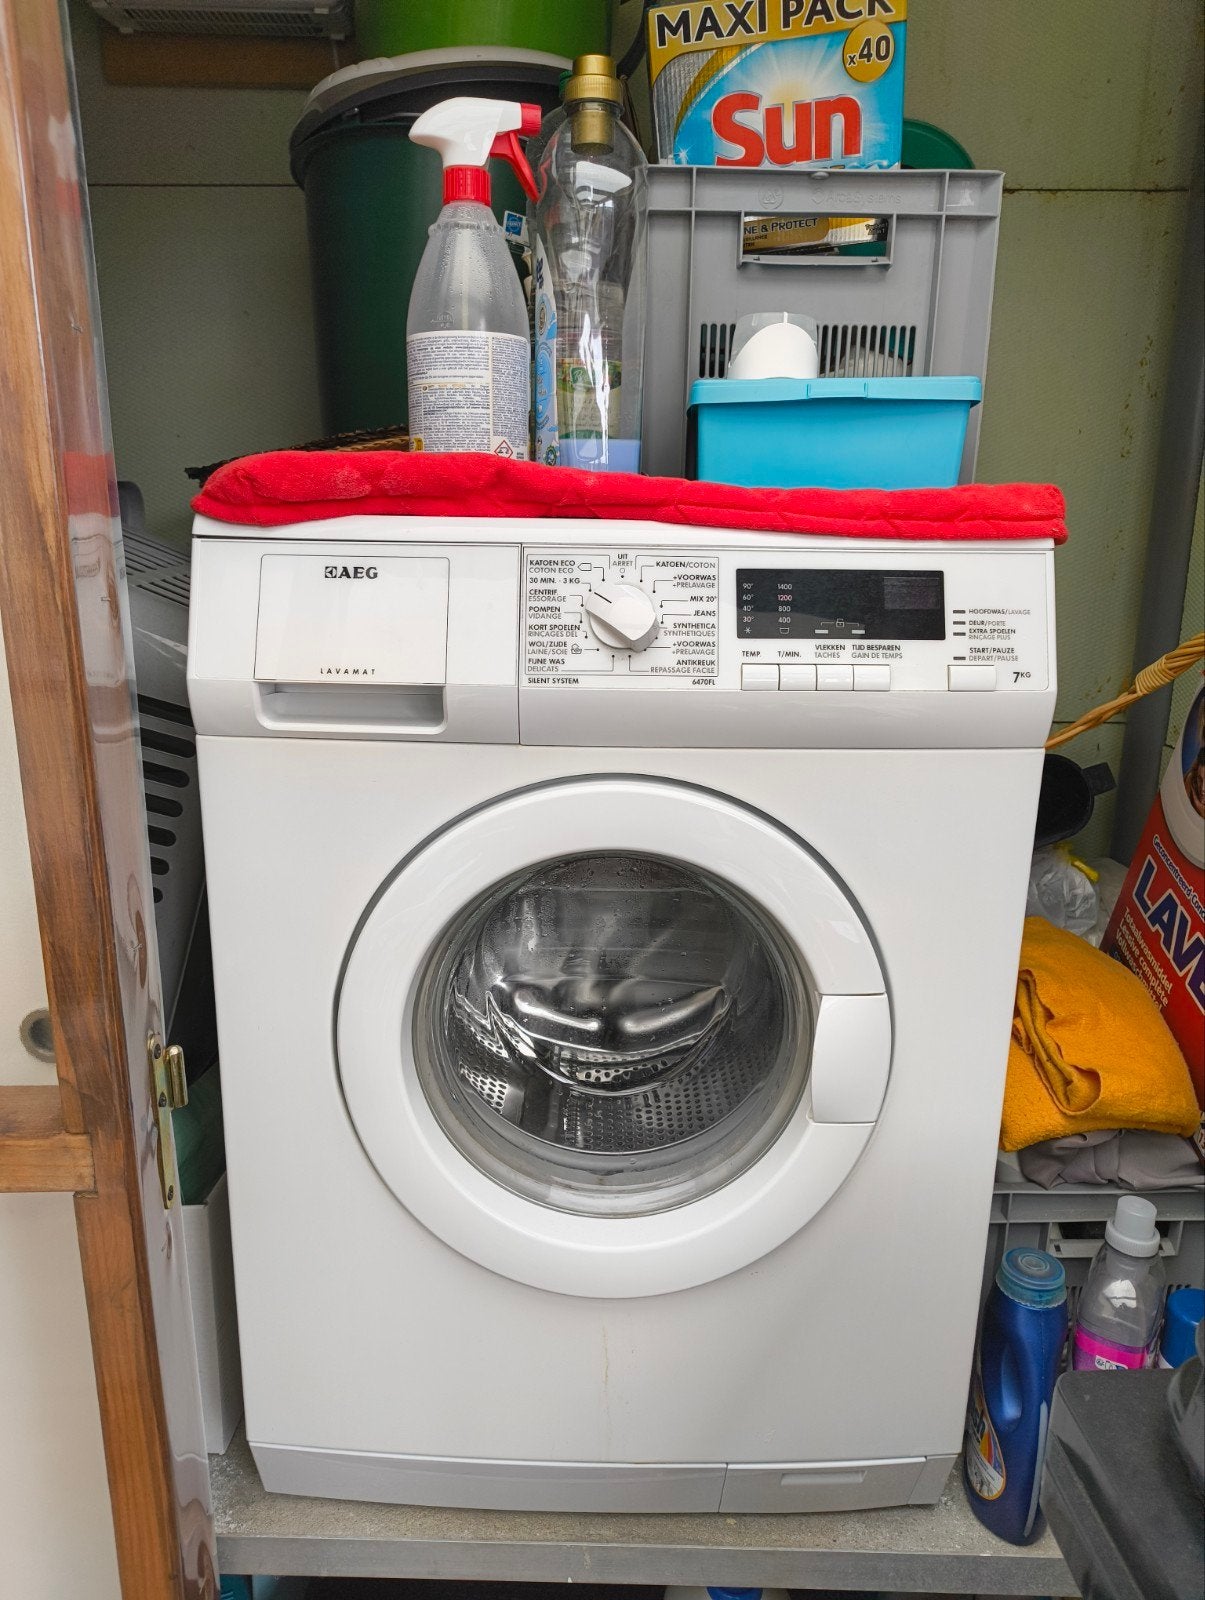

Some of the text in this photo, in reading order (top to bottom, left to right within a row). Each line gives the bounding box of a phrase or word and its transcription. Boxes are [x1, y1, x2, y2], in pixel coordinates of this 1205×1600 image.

[656, 0, 767, 48] MAXI
[847, 35, 891, 66] x40
[712, 93, 862, 167] Sun
[744, 218, 818, 235] NE & PROTECT
[655, 561, 716, 569] KATOEN/COTON
[338, 566, 379, 580] AEG
[777, 583, 793, 591] 1400
[777, 594, 793, 602] 1200
[693, 609, 717, 617] JEANS
[778, 605, 791, 613] 800
[968, 608, 1031, 616] HOOFDWAS/LAVAGE
[778, 616, 791, 624] 400
[673, 622, 717, 630] SYNTHETICA
[528, 648, 568, 656] LAINE/SOIE
[867, 644, 901, 652] BESPAREN
[969, 647, 1015, 655] START/PAUZE
[741, 650, 762, 658] TEMP.
[778, 650, 802, 658] T/MIN.
[881, 652, 903, 660] TEMPS
[676, 659, 716, 667] ANTIKREUK
[968, 655, 1019, 663] DEPART/PAUSE
[320, 667, 376, 675] LAVAMAT
